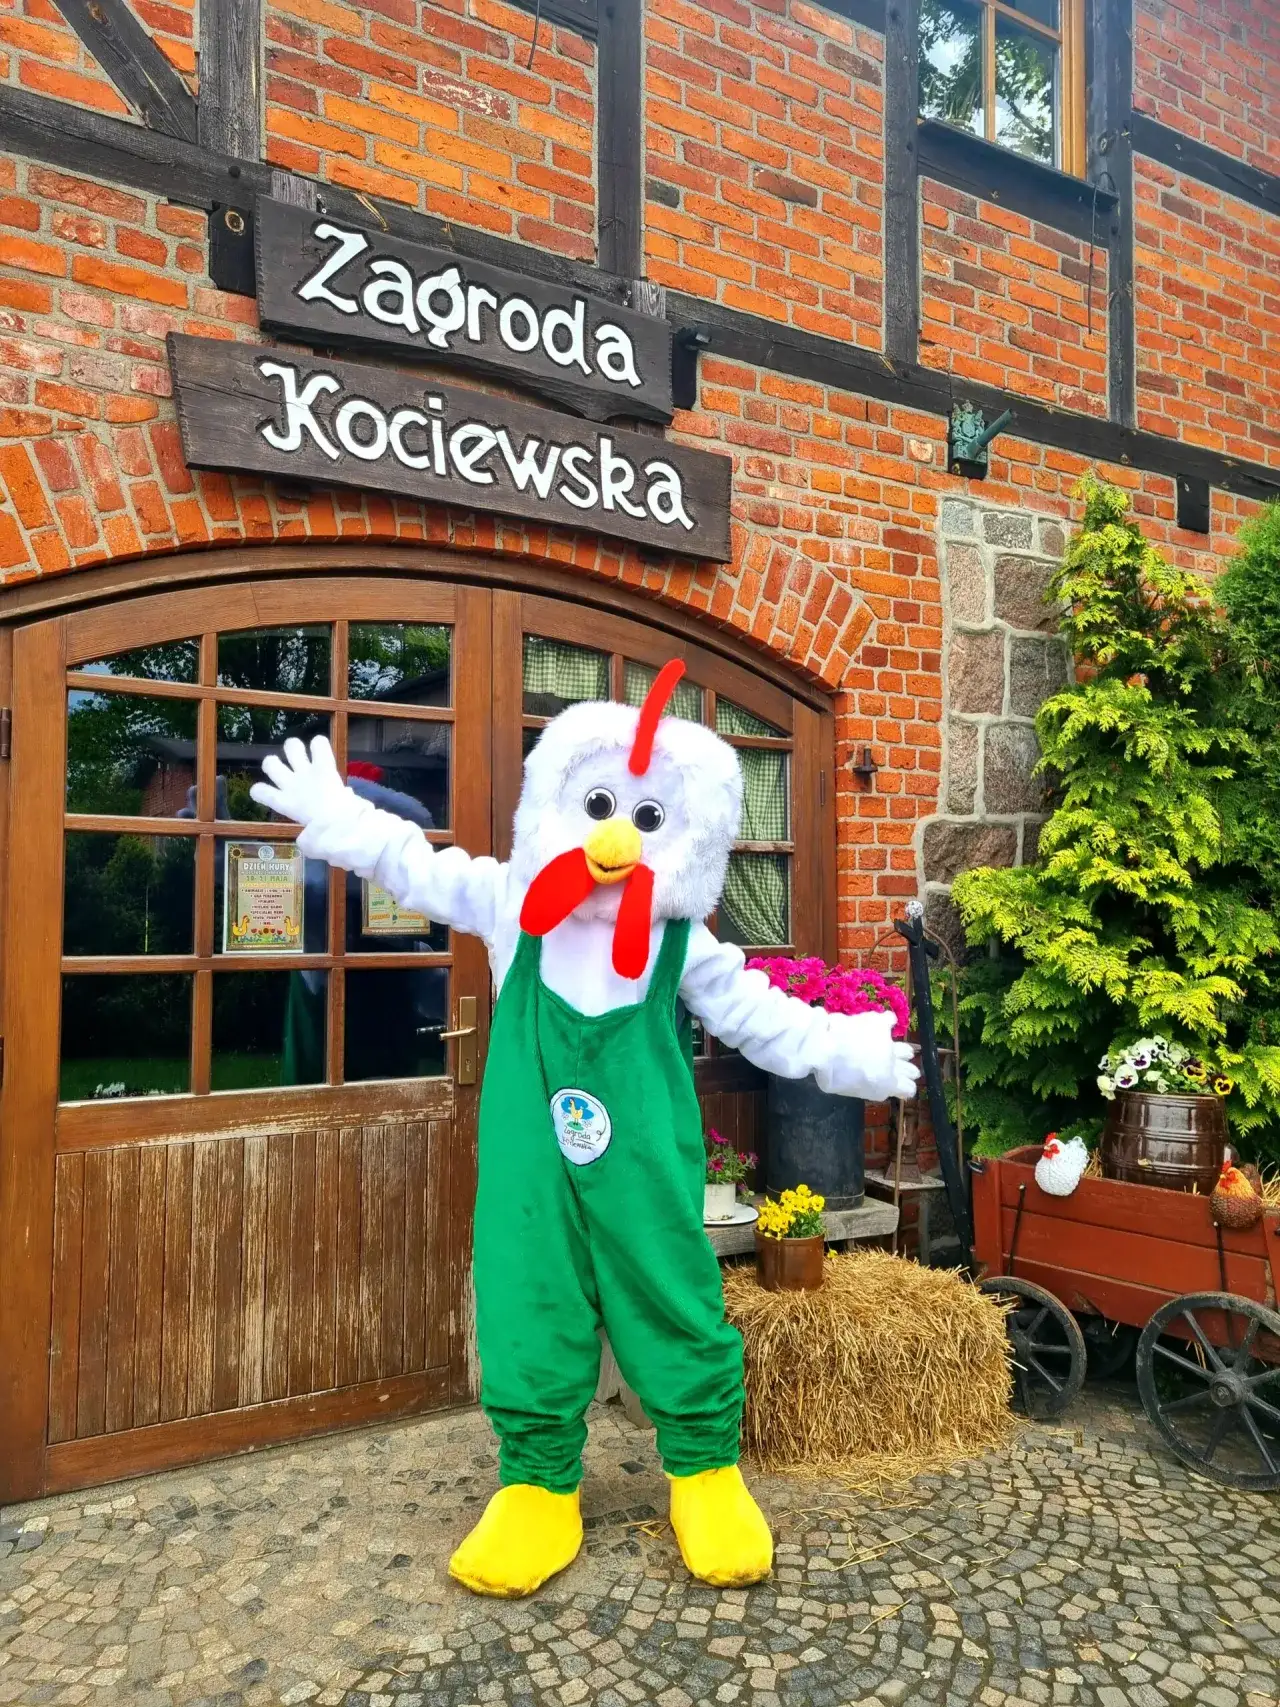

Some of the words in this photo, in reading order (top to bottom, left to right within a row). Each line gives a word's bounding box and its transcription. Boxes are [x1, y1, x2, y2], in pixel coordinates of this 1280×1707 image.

[297, 222, 643, 388] Zagroda
[258, 360, 696, 531] Kociewska
[269, 863, 290, 871] KURY
[563, 1126, 591, 1141] Zagroda
